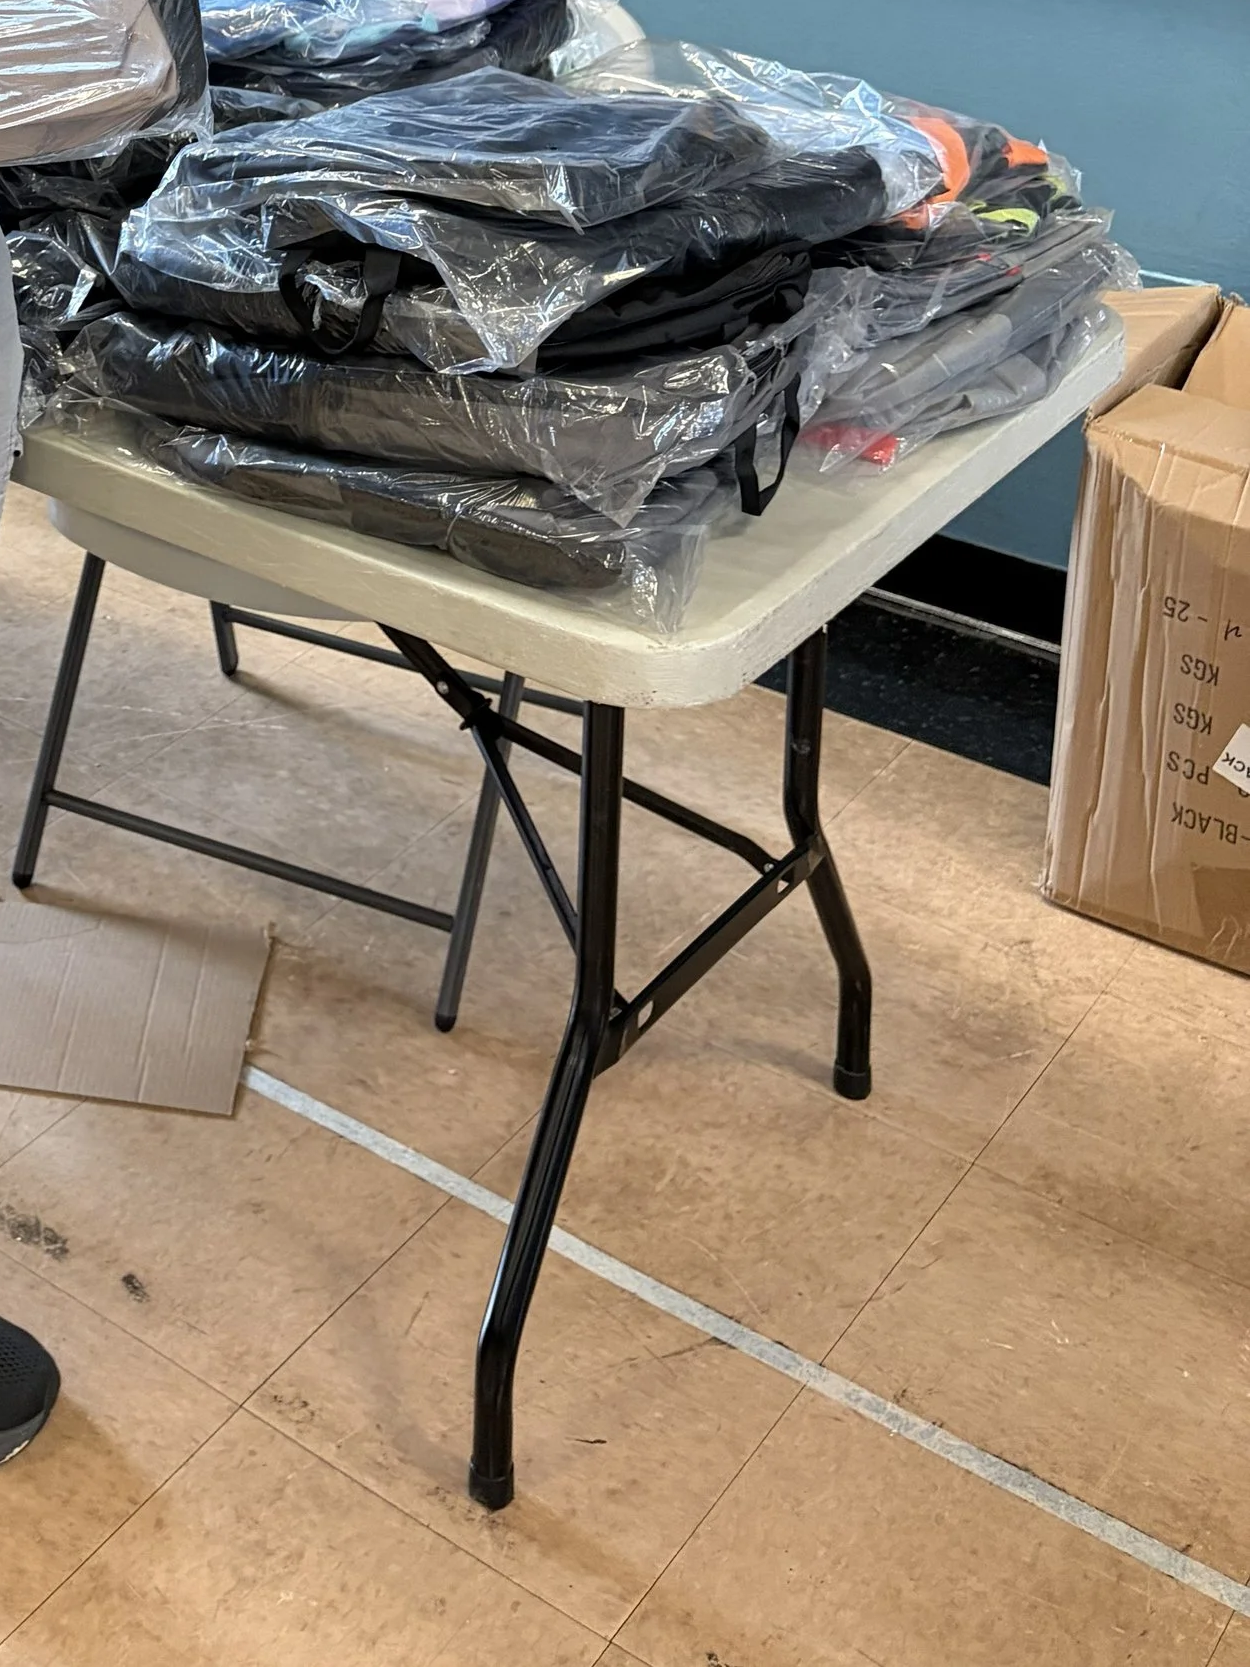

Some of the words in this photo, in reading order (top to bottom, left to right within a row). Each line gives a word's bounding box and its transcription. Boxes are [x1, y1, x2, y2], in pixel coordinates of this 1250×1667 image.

[1162, 595, 1191, 623] 25
[1179, 653, 1219, 686] KGS
[1172, 702, 1213, 736] KGS
[1166, 750, 1210, 786] PCS
